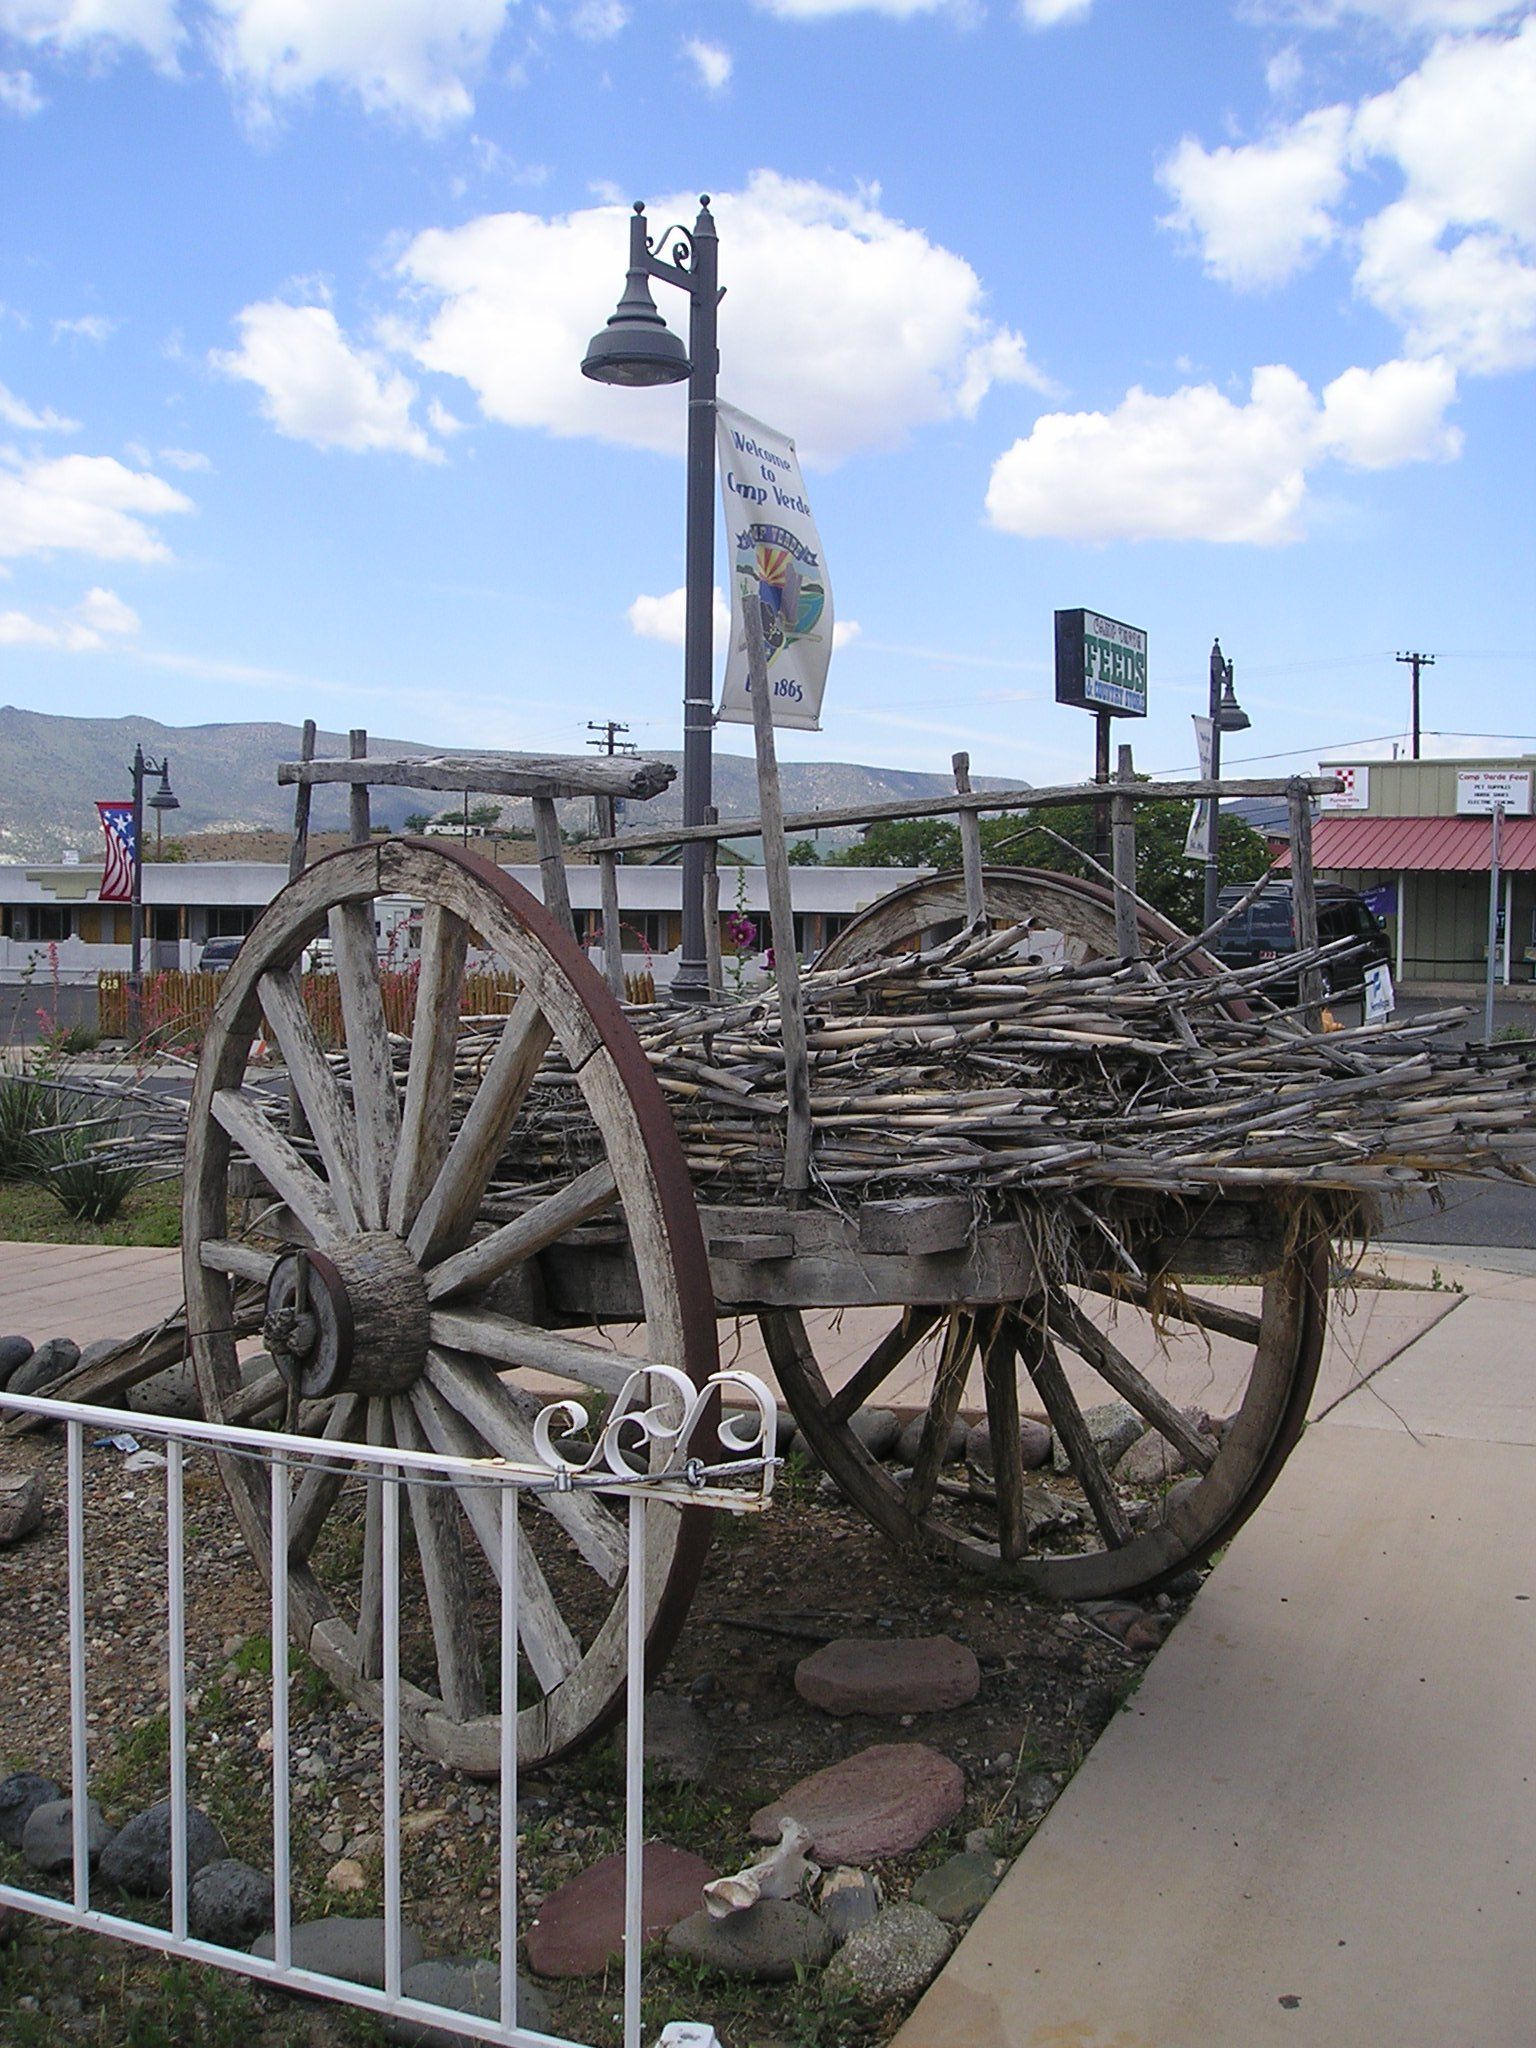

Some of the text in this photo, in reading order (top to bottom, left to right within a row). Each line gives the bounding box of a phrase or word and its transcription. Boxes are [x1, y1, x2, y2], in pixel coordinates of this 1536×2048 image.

[731, 430, 792, 472] Welcome
[760, 464, 776, 483] to
[772, 486, 811, 516] Verde
[1085, 634, 1145, 693] FEEDS
[773, 678, 803, 703] 1865
